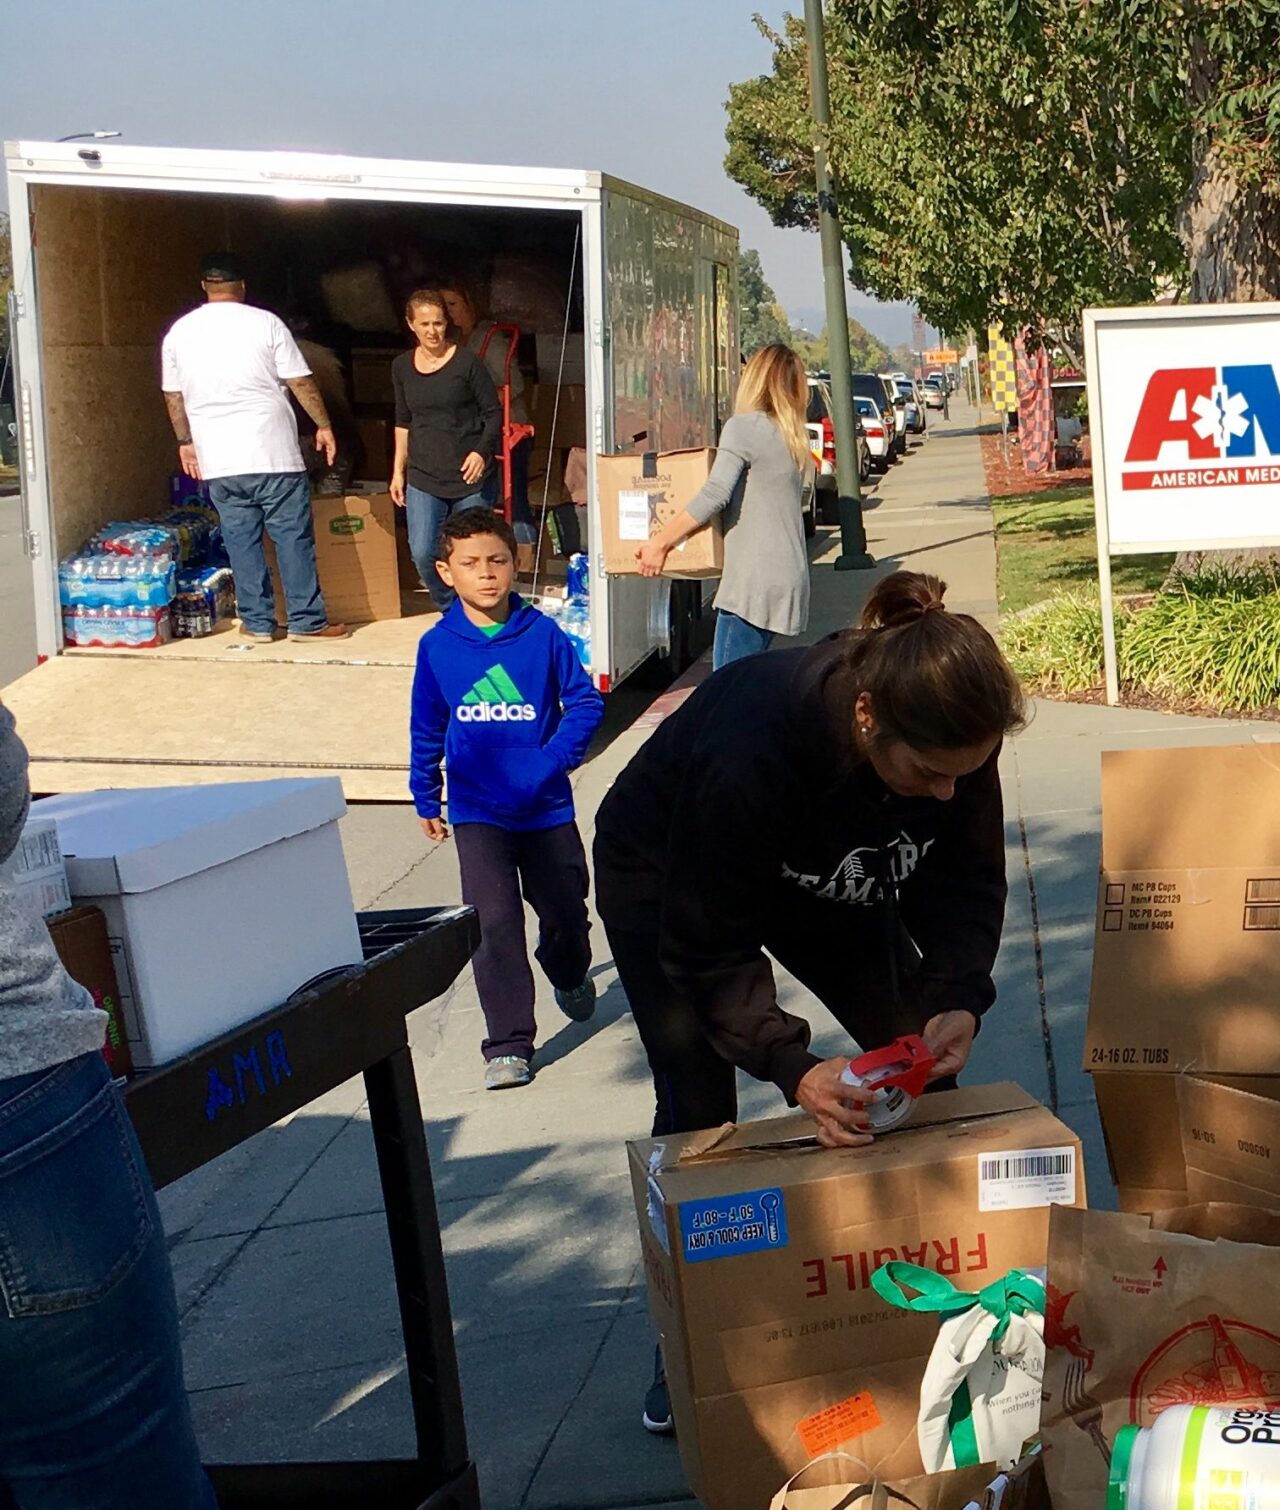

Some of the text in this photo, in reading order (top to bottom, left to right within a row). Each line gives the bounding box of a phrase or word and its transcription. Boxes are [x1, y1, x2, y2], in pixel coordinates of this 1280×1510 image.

[1151, 471, 1239, 487] AMERICAN
[456, 701, 537, 722] adidas
[1131, 882, 1176, 893] MC PB Cups
[1129, 909, 1172, 918] DC PB Cups
[1092, 1048, 1169, 1064] 24-16 OZ. TUBS
[205, 1028, 293, 1123] AMR
[687, 1222, 765, 1250] KEEP COOL & DRY
[1001, 1397, 1035, 1416] nothing
